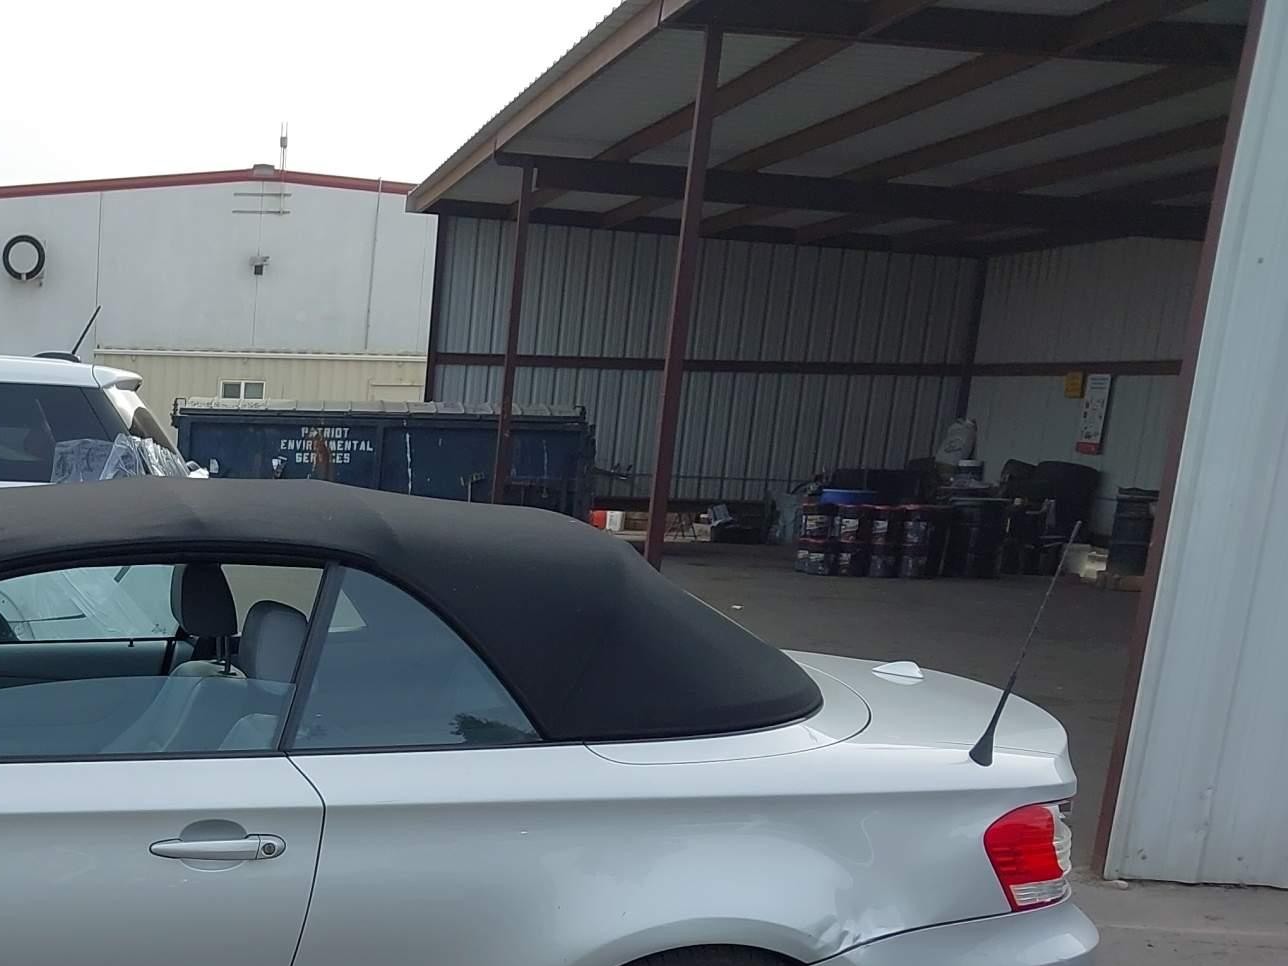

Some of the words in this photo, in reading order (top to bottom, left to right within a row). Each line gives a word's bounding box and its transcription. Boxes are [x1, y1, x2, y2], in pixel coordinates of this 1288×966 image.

[301, 427, 350, 438] PATRIOT
[280, 439, 373, 452] ENVIRMENTAL
[295, 452, 351, 464] SERCES
